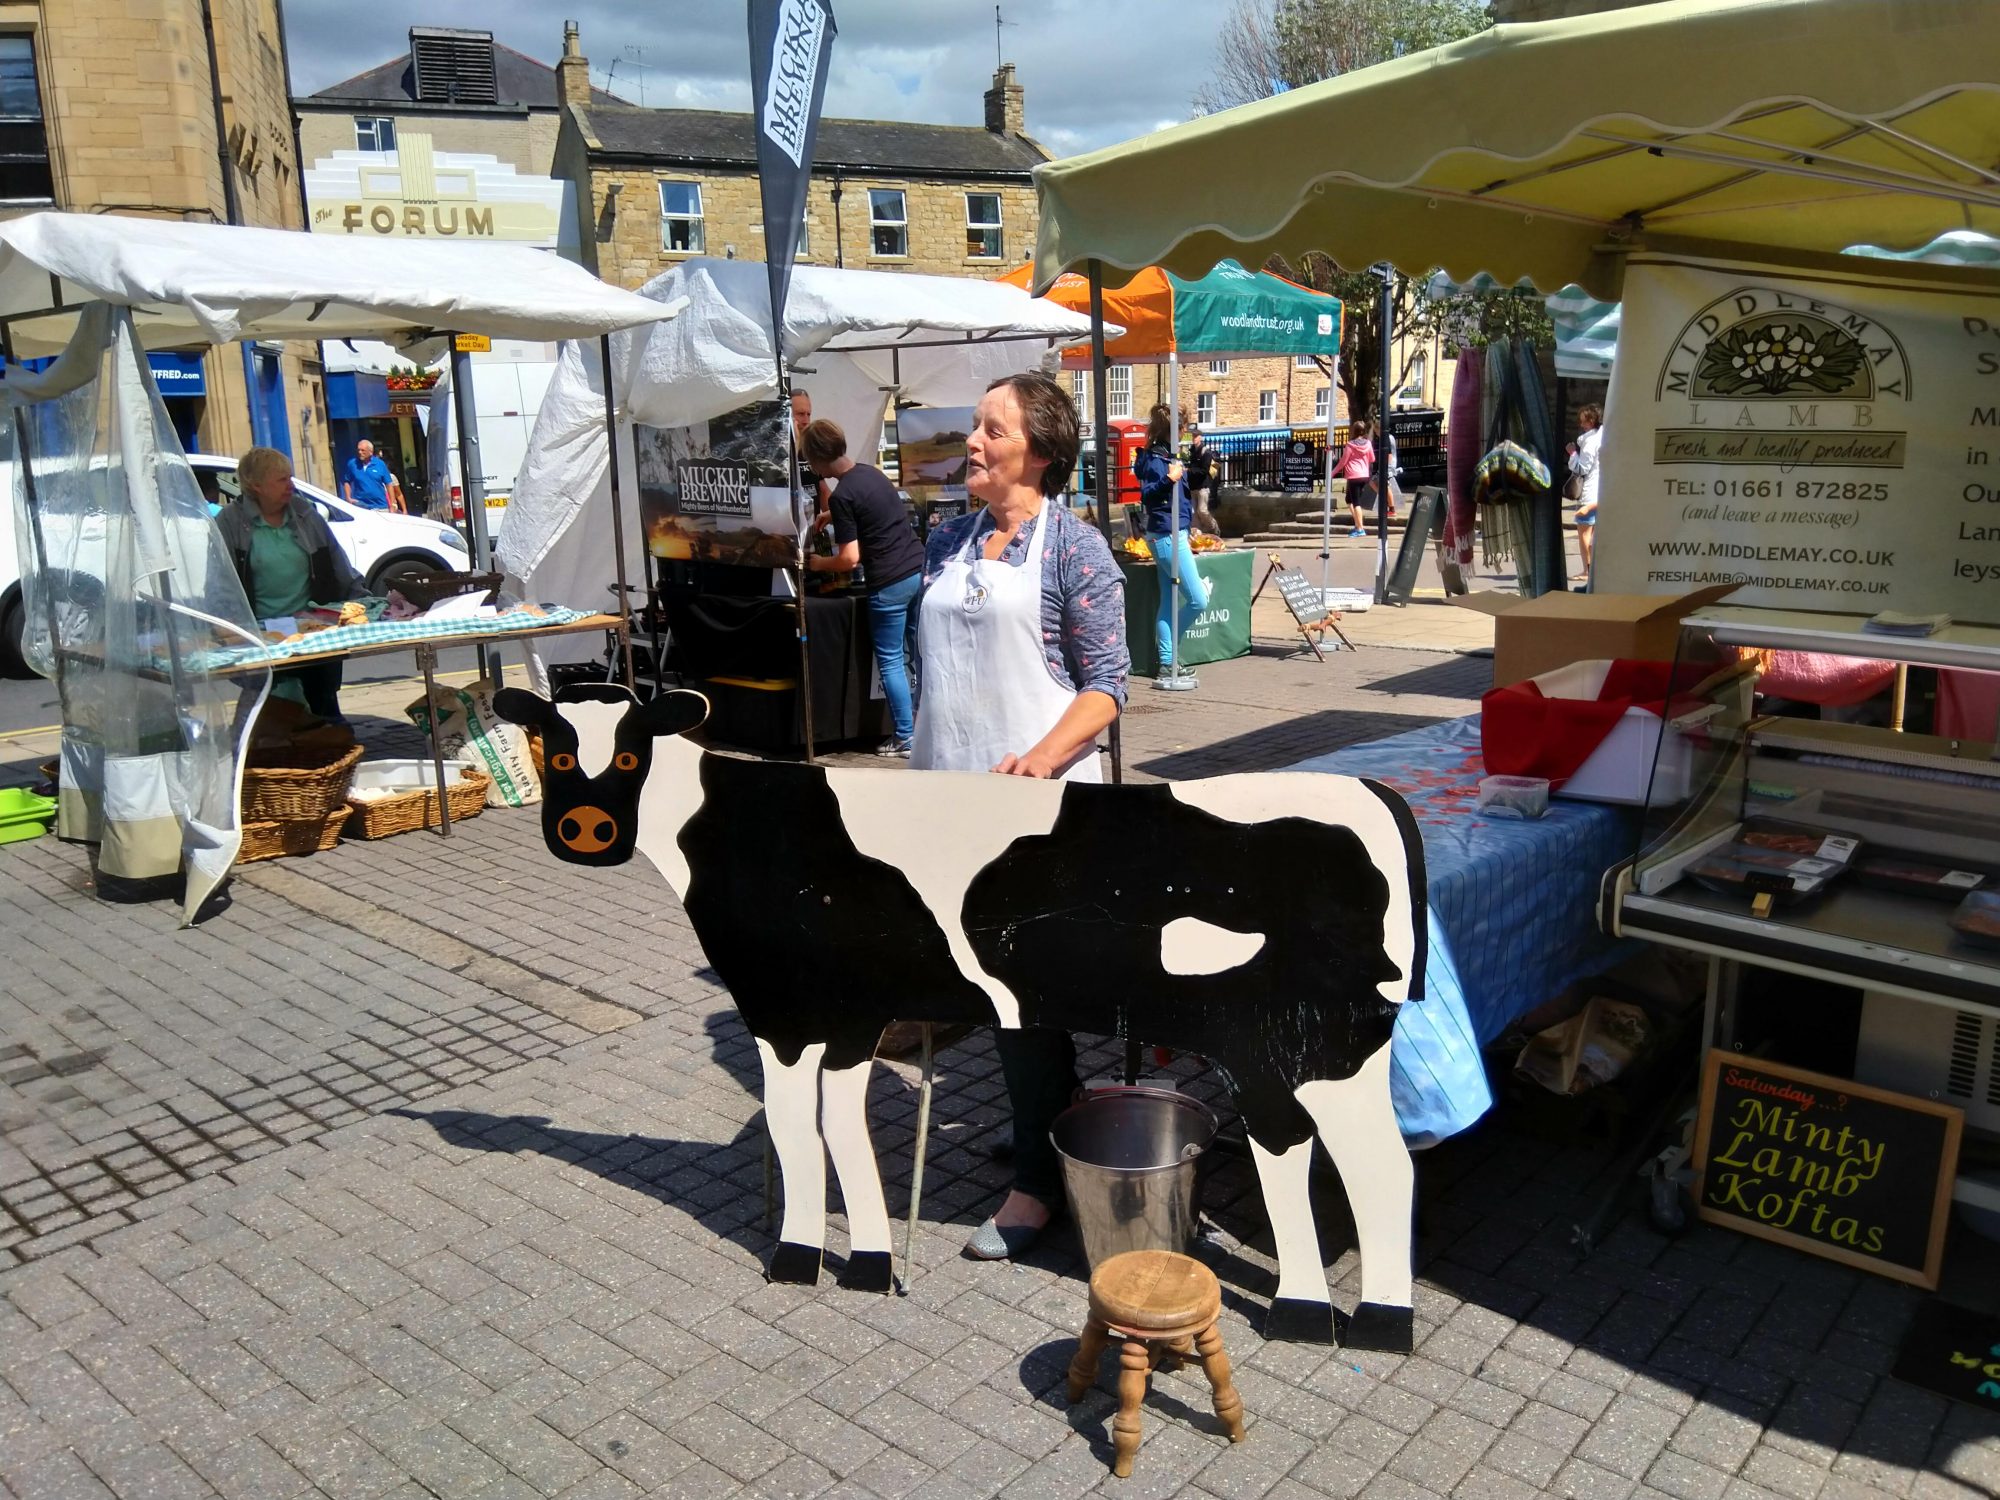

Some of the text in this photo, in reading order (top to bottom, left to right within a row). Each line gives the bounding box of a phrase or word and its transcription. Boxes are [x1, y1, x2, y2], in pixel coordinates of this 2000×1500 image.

[800, 97, 810, 125] Beers
[806, 10, 824, 86] Northumberland
[315, 205, 494, 236] The FORUM
[1220, 312, 1305, 334] woodlandtrust.org.uk
[1666, 293, 1902, 397] MIDDLEMAY
[152, 369, 200, 380] TFRED.com
[1690, 403, 1873, 427] LAMB
[1664, 435, 1897, 474] Fresh and locally produced
[1966, 447, 1988, 465] in
[679, 466, 748, 488] MUCKLE
[681, 482, 748, 505] BREWING
[1664, 479, 1889, 501] TEL: 01661 872825
[681, 502, 696, 511] Mighty
[696, 503, 709, 511] Beers
[716, 504, 750, 514] Northumberland
[1681, 503, 1860, 529] (and leave a message)
[1648, 542, 1895, 567] WWW.MIDDLEMAY.CO.UK
[1647, 571, 1890, 595] FRESHLAMB@MIDDLEMAY.CO.UK
[1185, 628, 1210, 639] TRUST
[493, 723, 511, 754] Farm
[1725, 1068, 1816, 1111] Saturday
[1729, 1098, 1886, 1180] Minty
[1713, 1131, 1862, 1197] Lamb
[1709, 1173, 1885, 1252] Koftas
